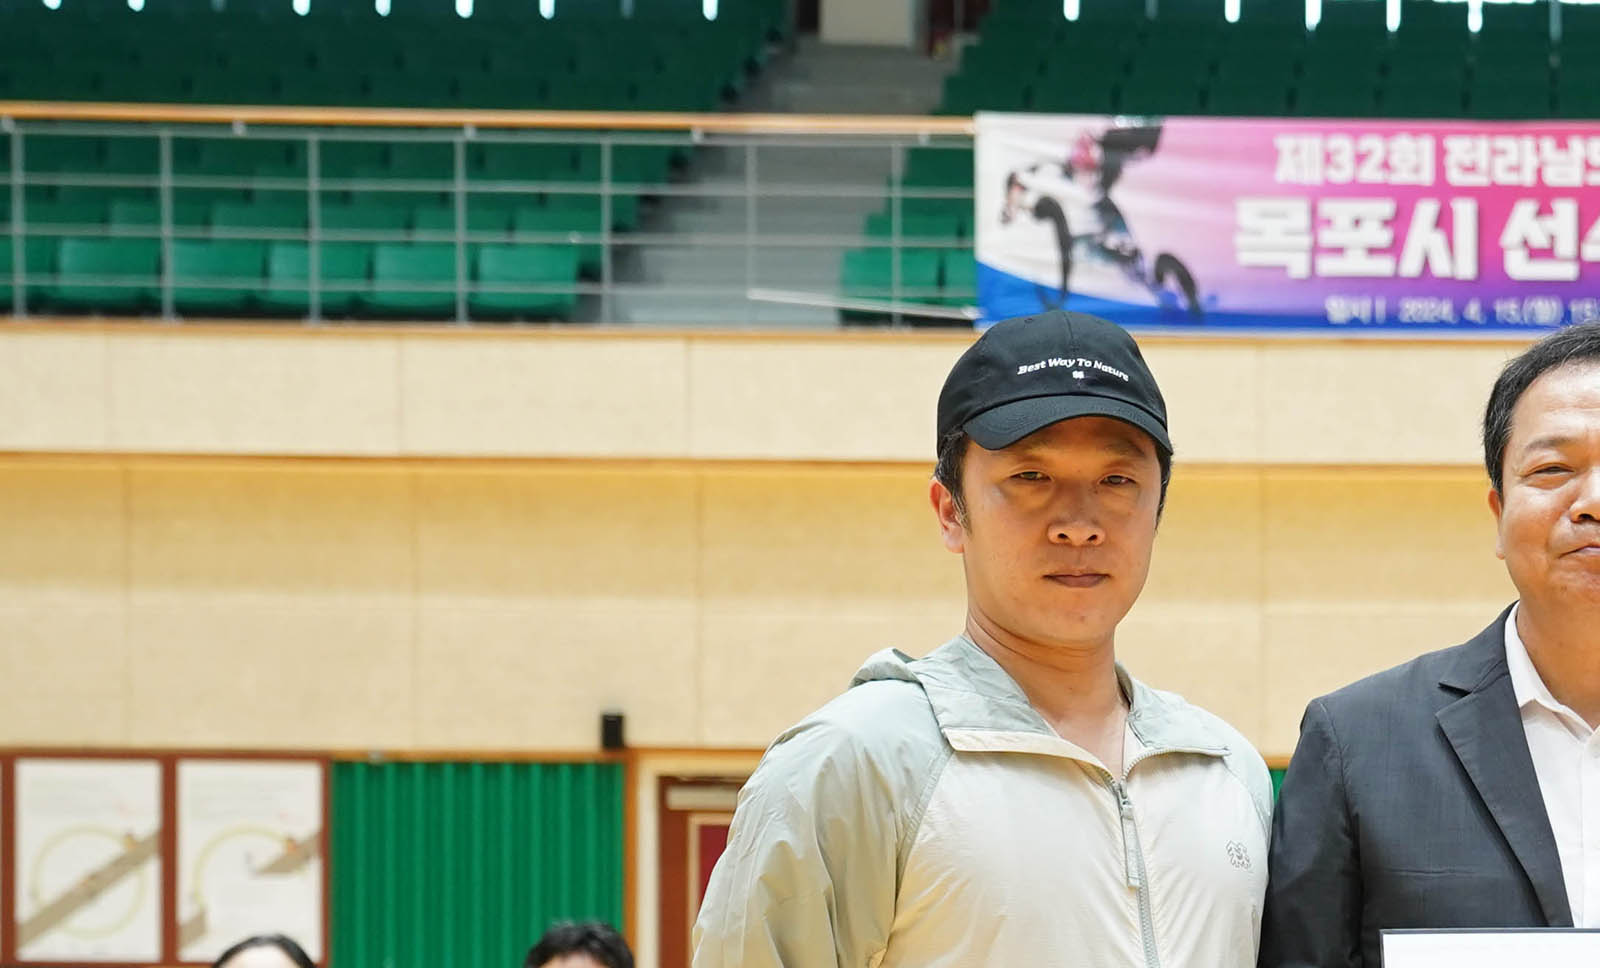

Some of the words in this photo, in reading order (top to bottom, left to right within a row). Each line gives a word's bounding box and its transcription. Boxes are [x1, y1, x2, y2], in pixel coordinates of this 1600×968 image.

[1274, 134, 1436, 185] 제32회
[1234, 198, 1479, 281] 목포시
[1017, 361, 1046, 375] Best
[1048, 357, 1075, 369] Way
[1077, 358, 1092, 368] To
[1093, 360, 1129, 382] Nature
